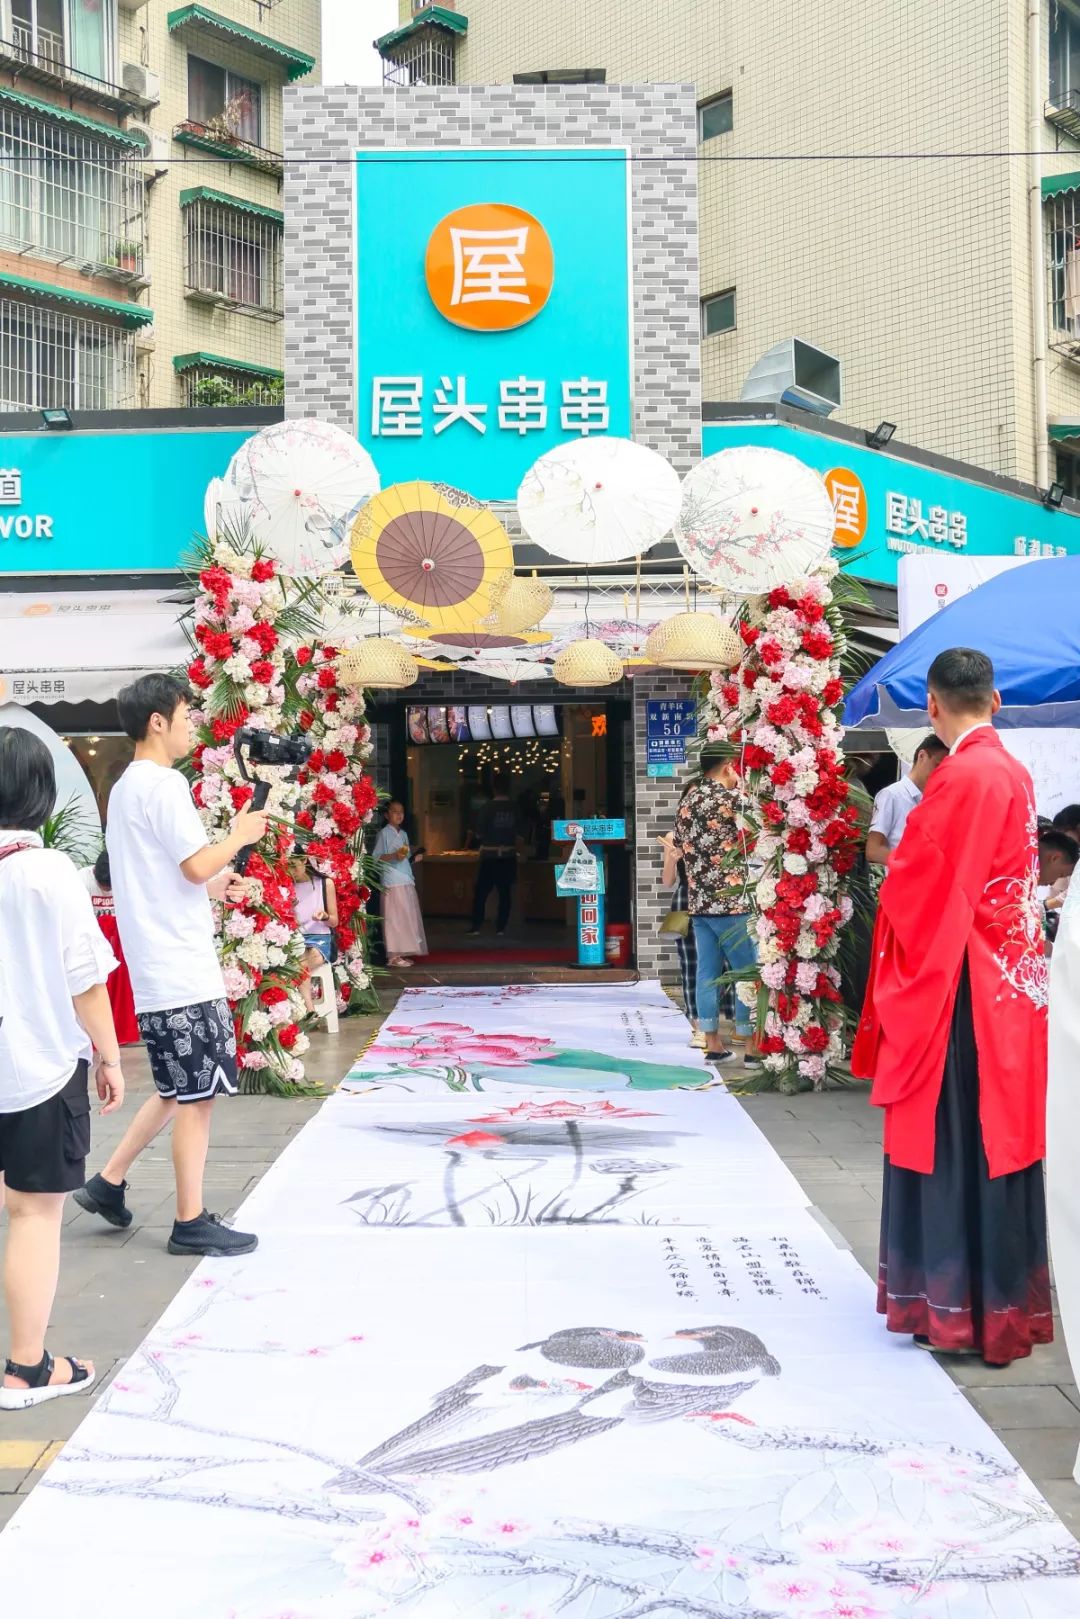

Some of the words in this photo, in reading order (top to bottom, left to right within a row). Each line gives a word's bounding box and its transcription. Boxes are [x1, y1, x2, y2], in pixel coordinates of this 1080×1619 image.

[449, 226, 531, 306] 屋
[371, 375, 610, 437] 屋头串串
[831, 480, 859, 536] 屋
[886, 490, 968, 547] 屋头串串
[13, 680, 65, 694] 屋头串串
[660, 702, 684, 711] 青羊区
[663, 723, 681, 736] 50
